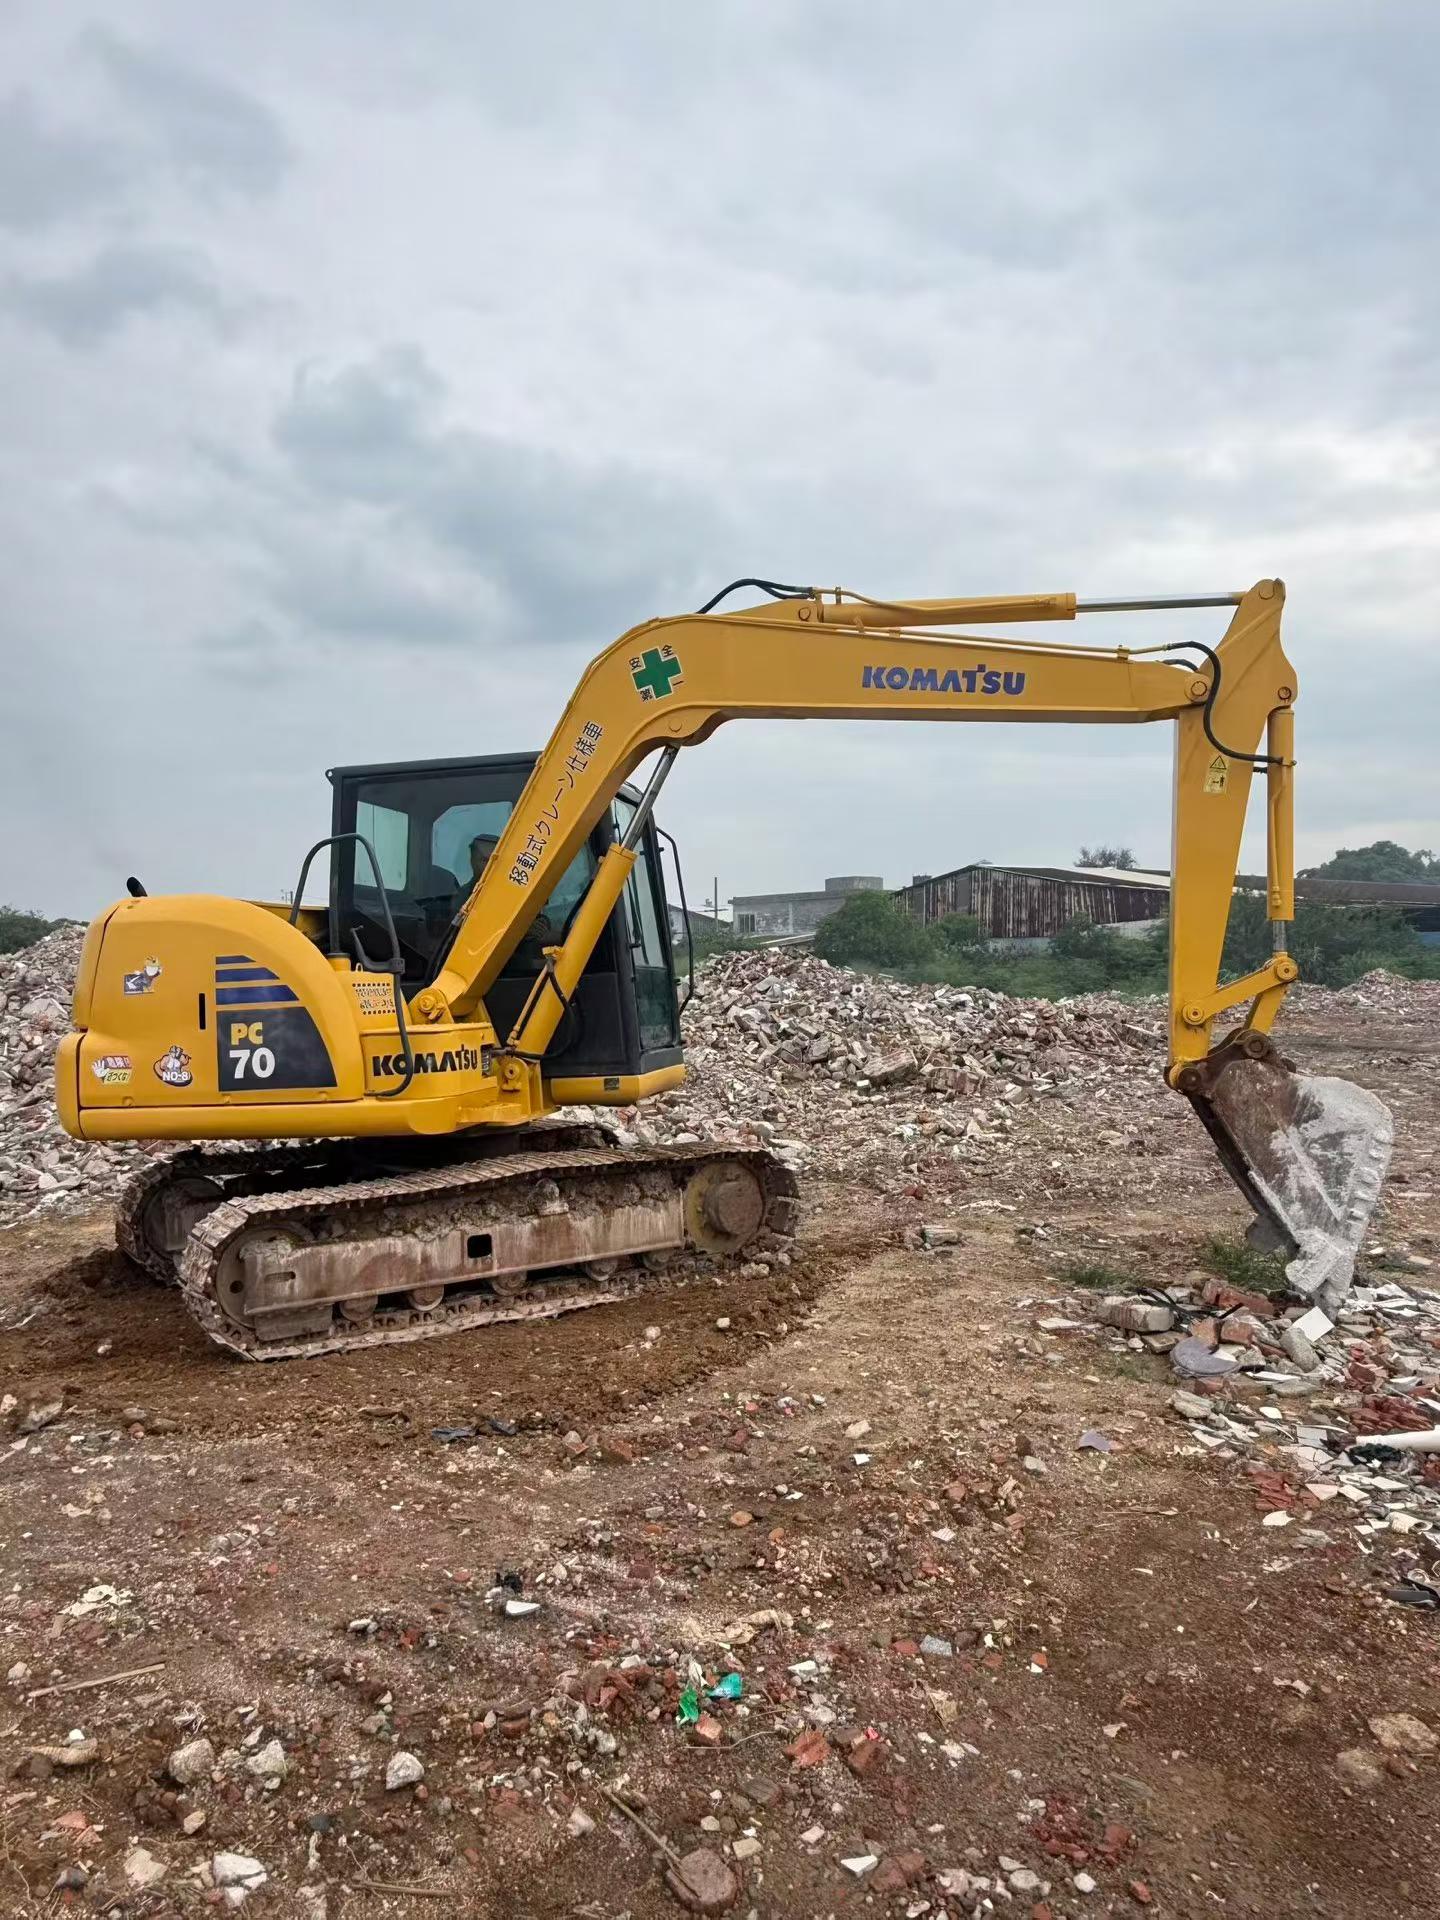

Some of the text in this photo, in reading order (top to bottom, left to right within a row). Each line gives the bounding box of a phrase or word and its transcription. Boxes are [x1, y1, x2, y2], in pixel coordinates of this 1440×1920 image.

[862, 664, 1026, 696] KOMATSU
[509, 720, 603, 886] 移動式クレーン仕様車
[230, 1021, 264, 1046] PC
[229, 1047, 276, 1079] 70
[372, 1043, 478, 1077] KOMATSU
